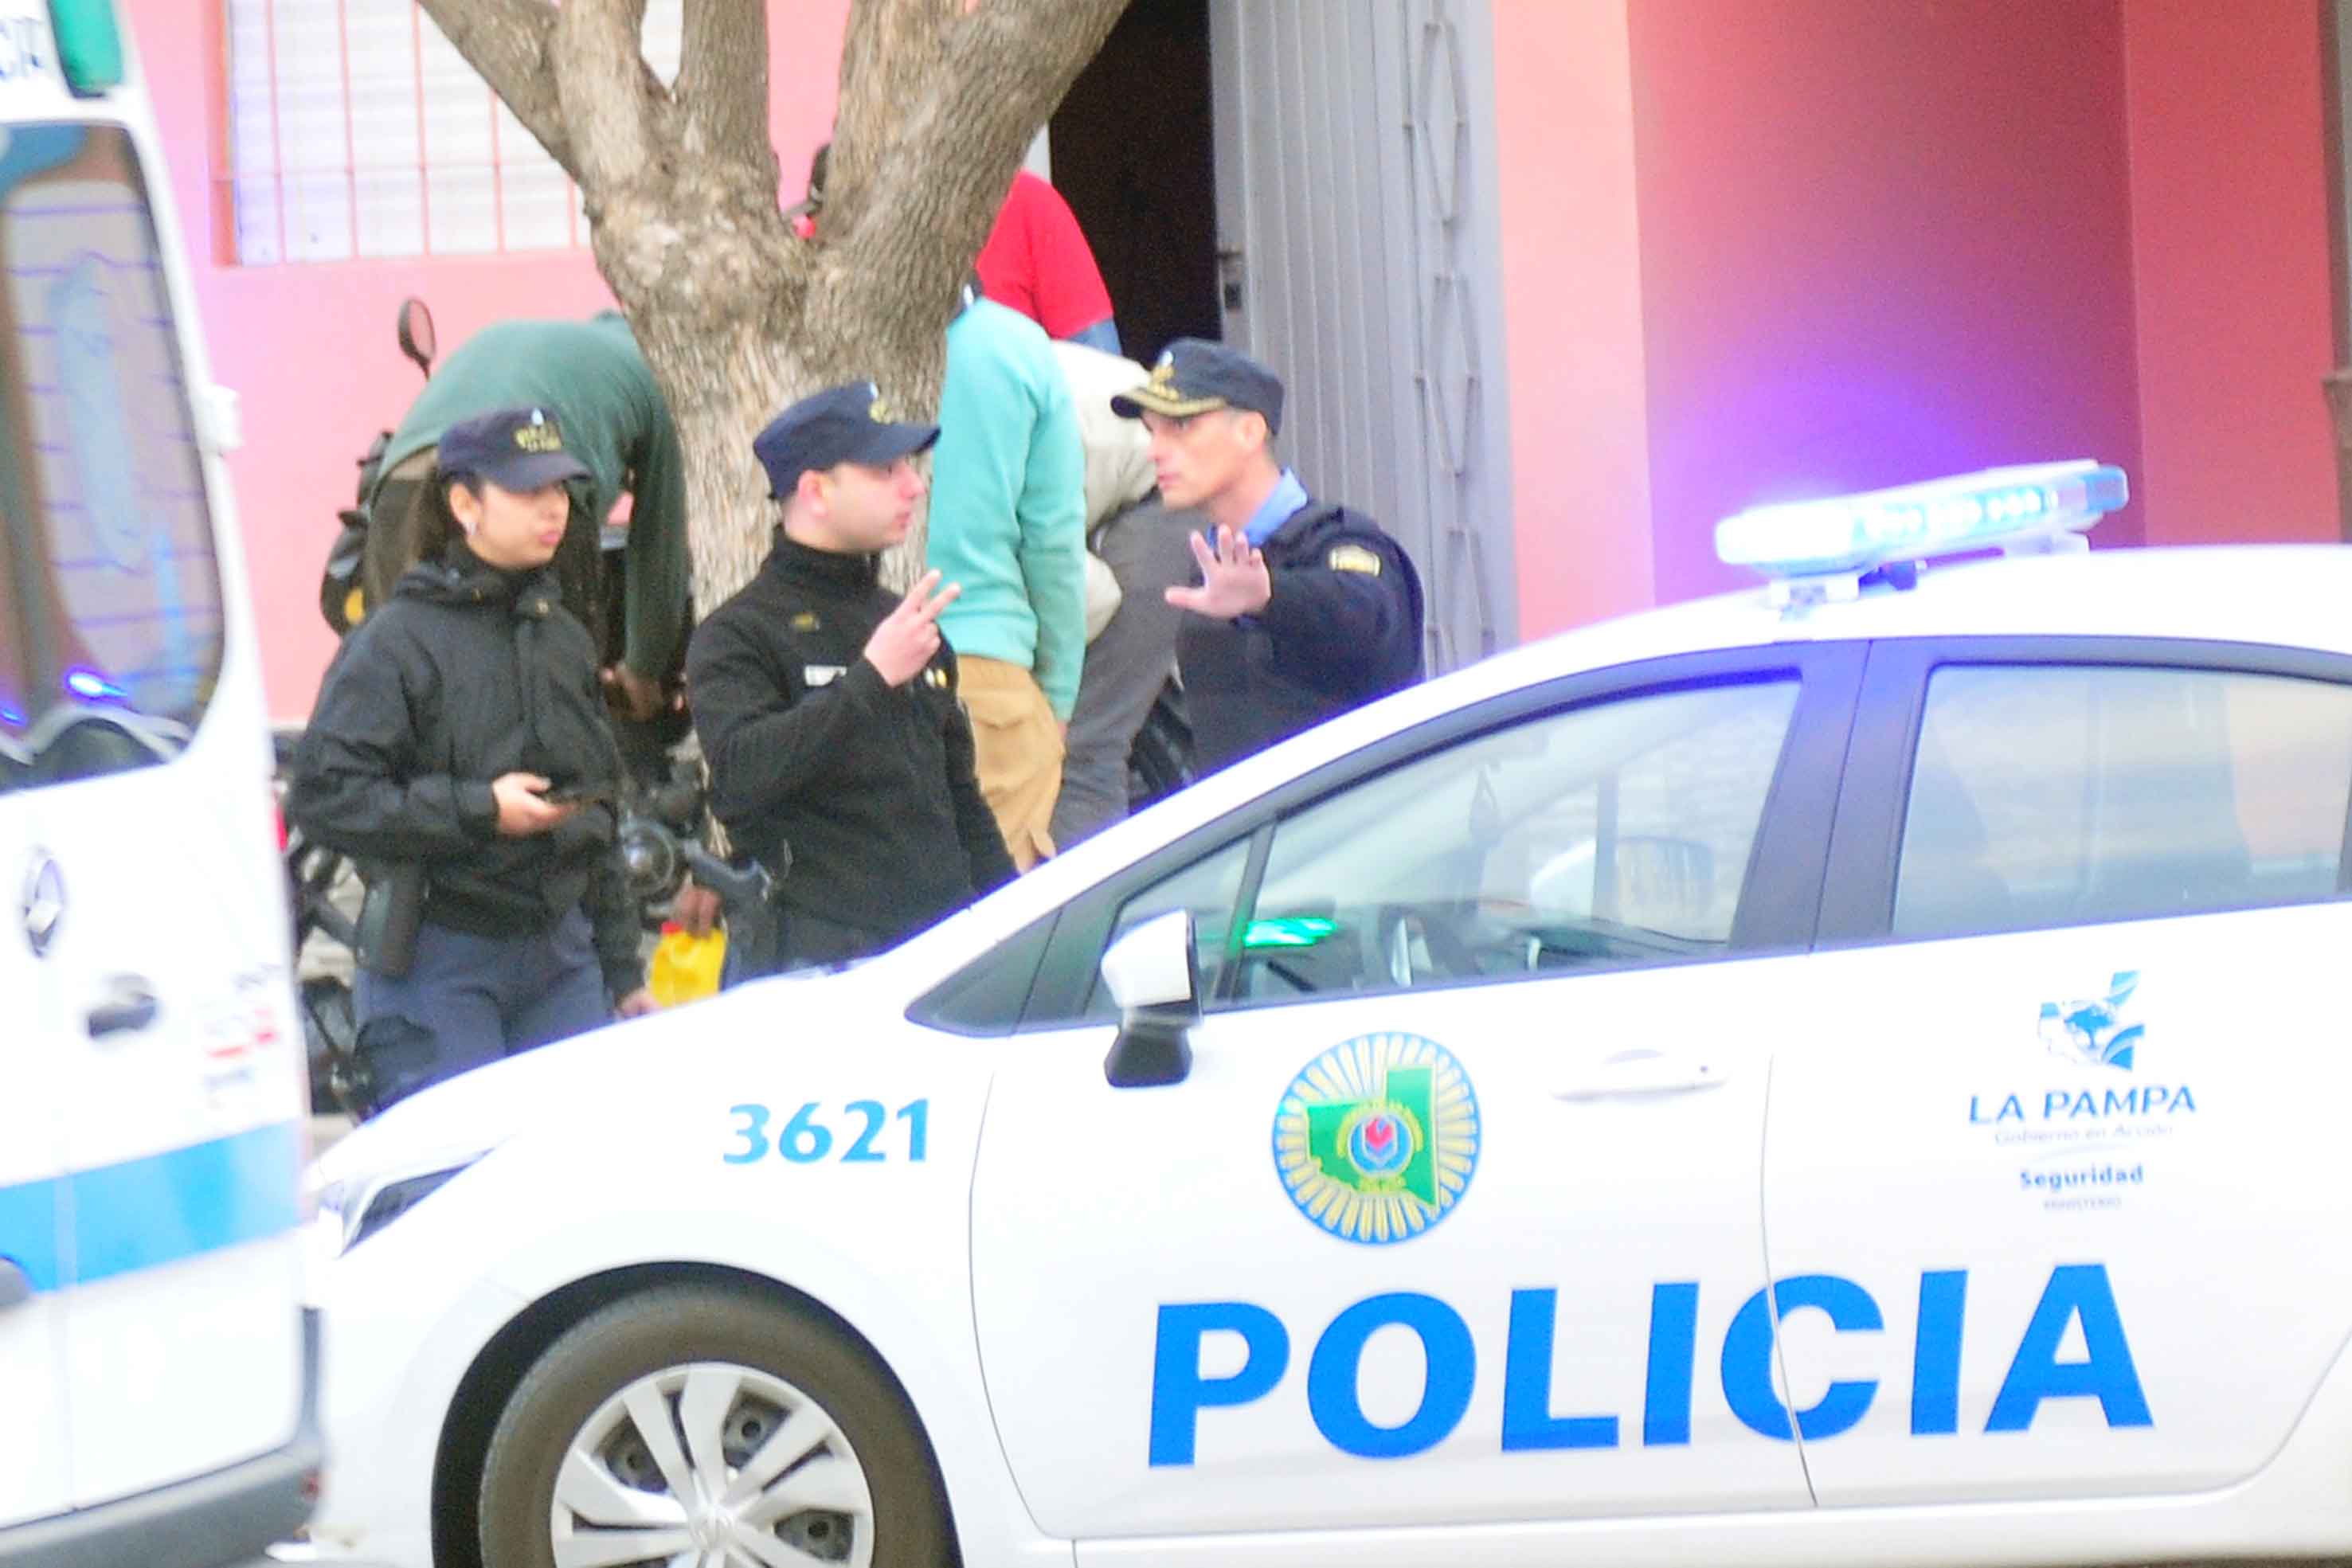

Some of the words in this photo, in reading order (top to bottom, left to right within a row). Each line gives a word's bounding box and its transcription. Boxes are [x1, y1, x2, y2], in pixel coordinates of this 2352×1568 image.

[1969, 1094, 2025, 1124] LA
[2043, 1085, 2197, 1119] PAMPA
[723, 1098, 929, 1164] 3621
[2020, 1163, 2144, 1190] Seguridad
[1149, 1264, 2154, 1468] POLICIA
